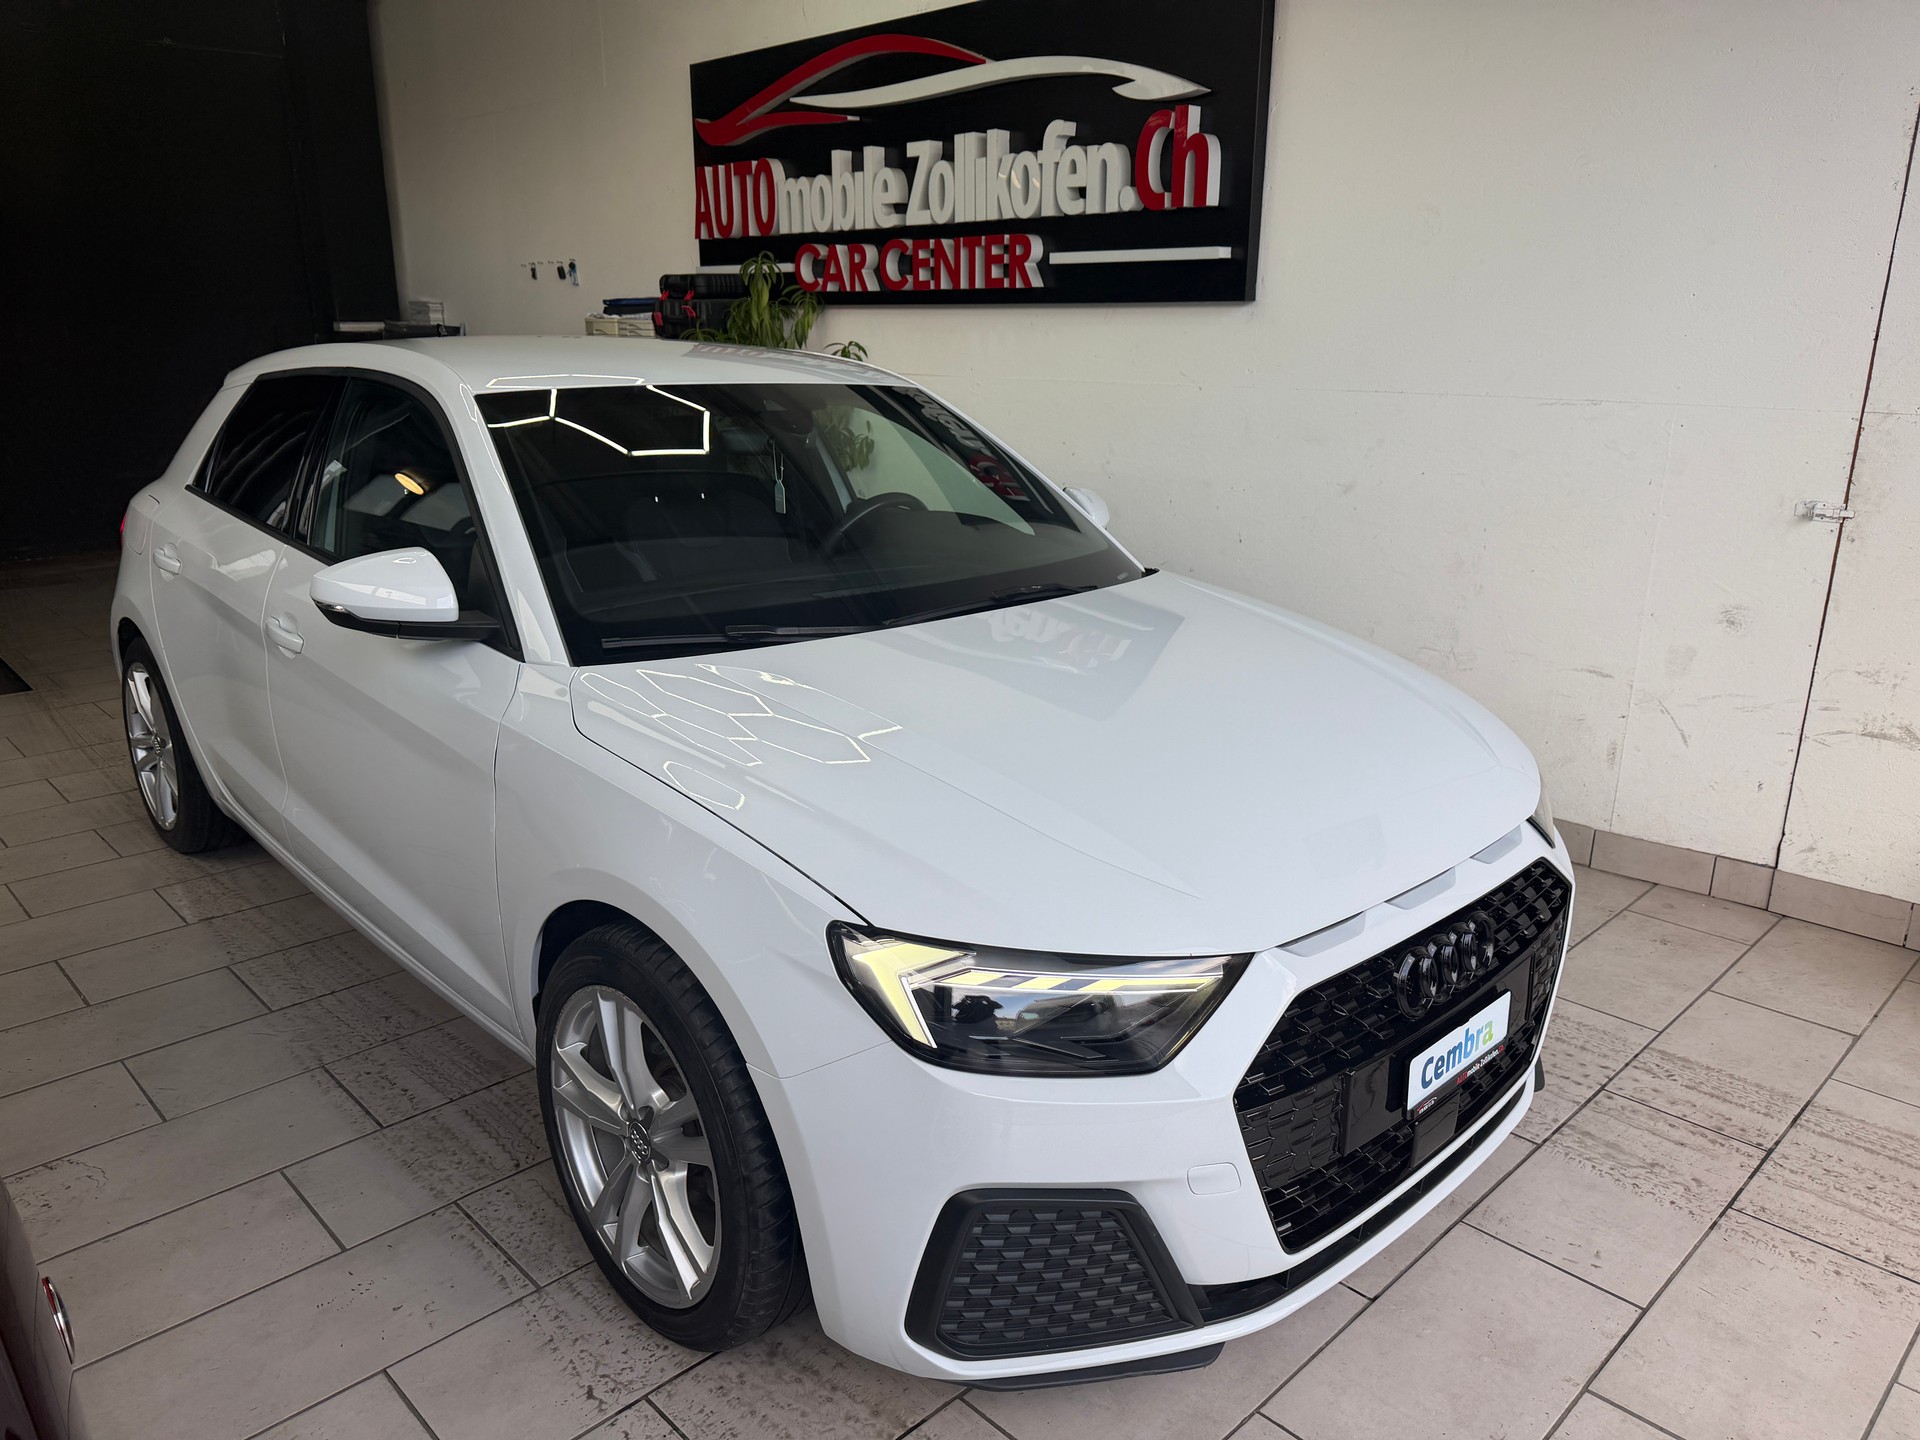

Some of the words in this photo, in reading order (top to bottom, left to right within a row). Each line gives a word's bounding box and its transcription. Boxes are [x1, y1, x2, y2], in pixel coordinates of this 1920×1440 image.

[795, 243, 879, 292] CAR
[880, 234, 1044, 290] CENTER
[1421, 1021, 1494, 1089] Cembra
